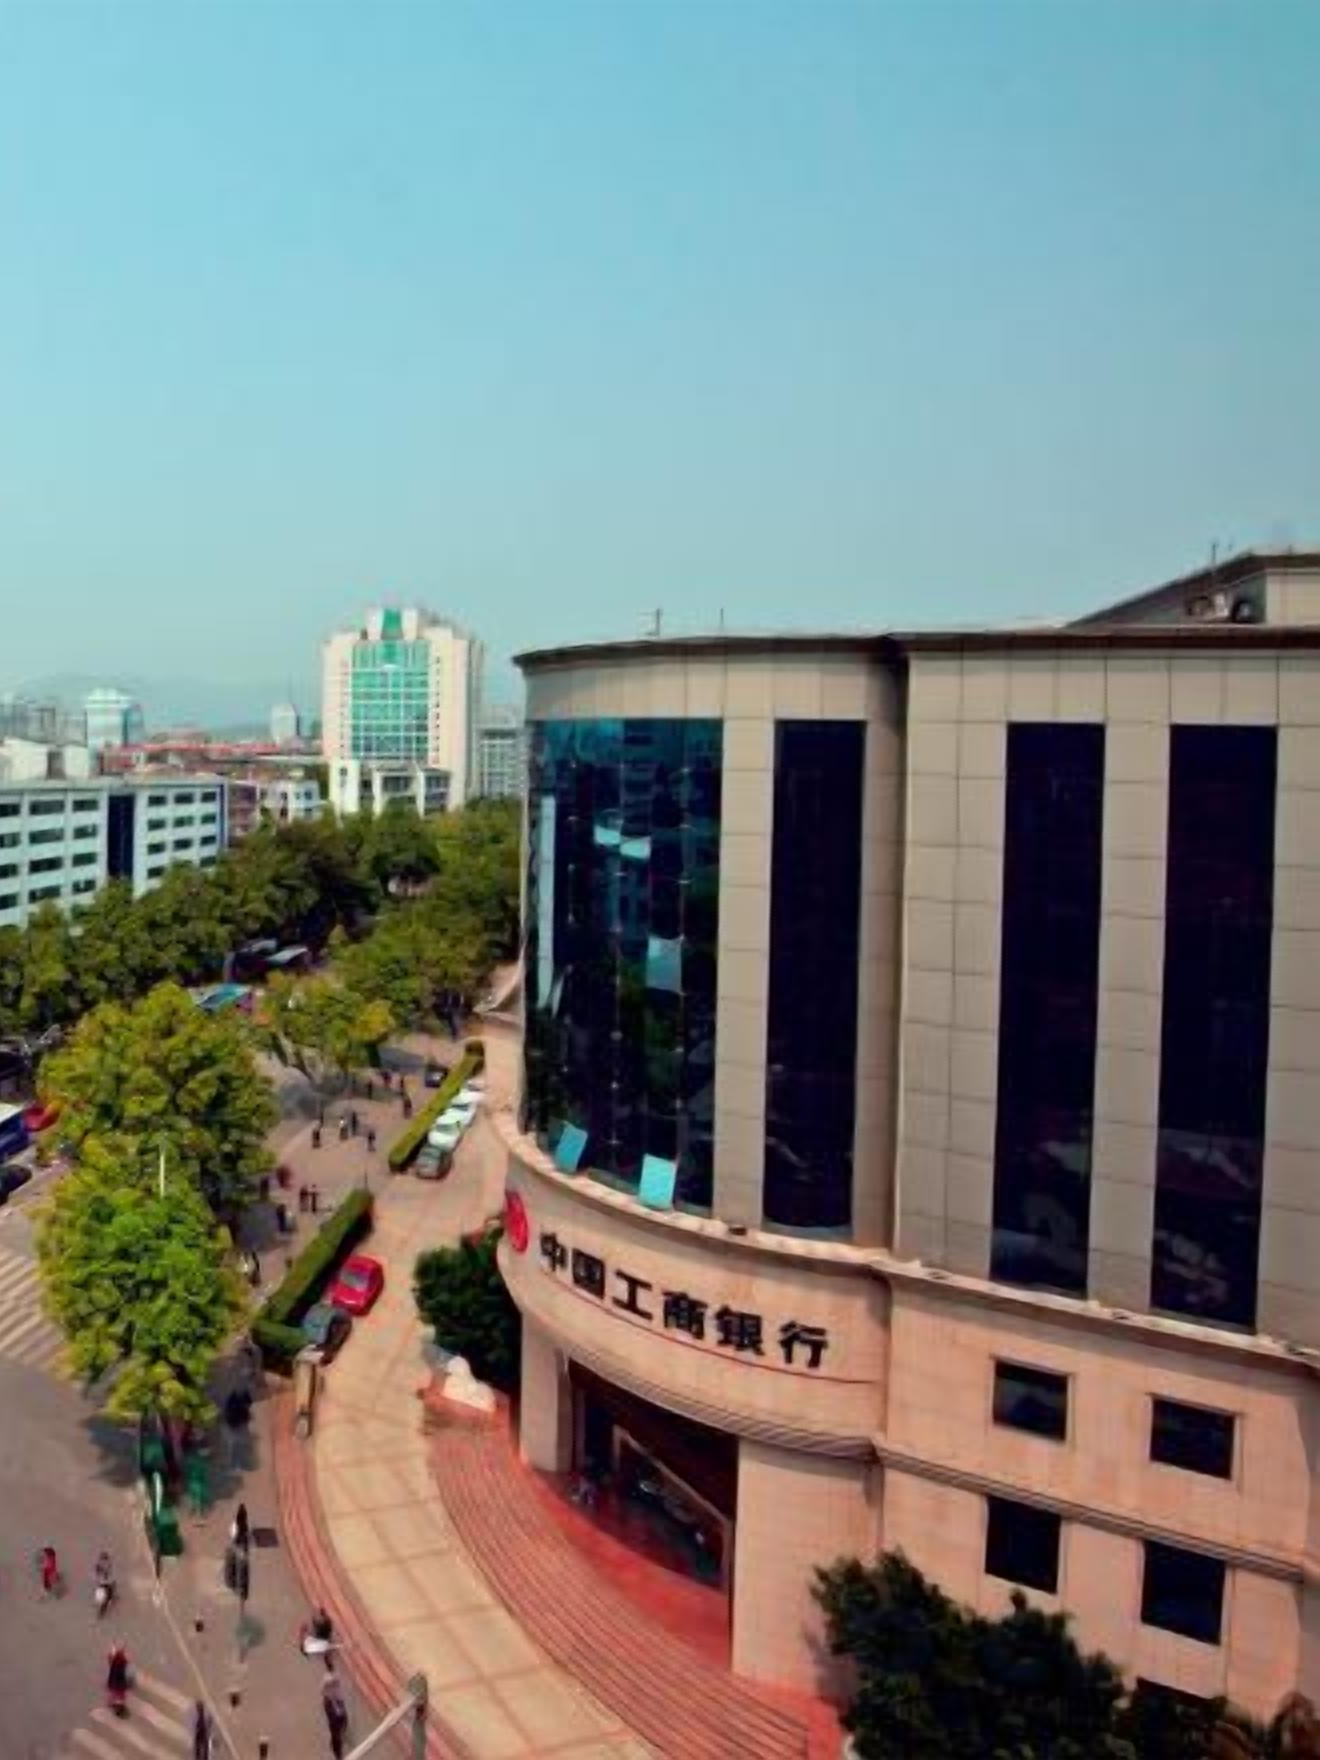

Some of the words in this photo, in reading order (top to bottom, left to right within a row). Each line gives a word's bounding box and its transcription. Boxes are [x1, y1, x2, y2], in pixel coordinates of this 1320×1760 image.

[539, 1232, 828, 1368] 中国工商银行
